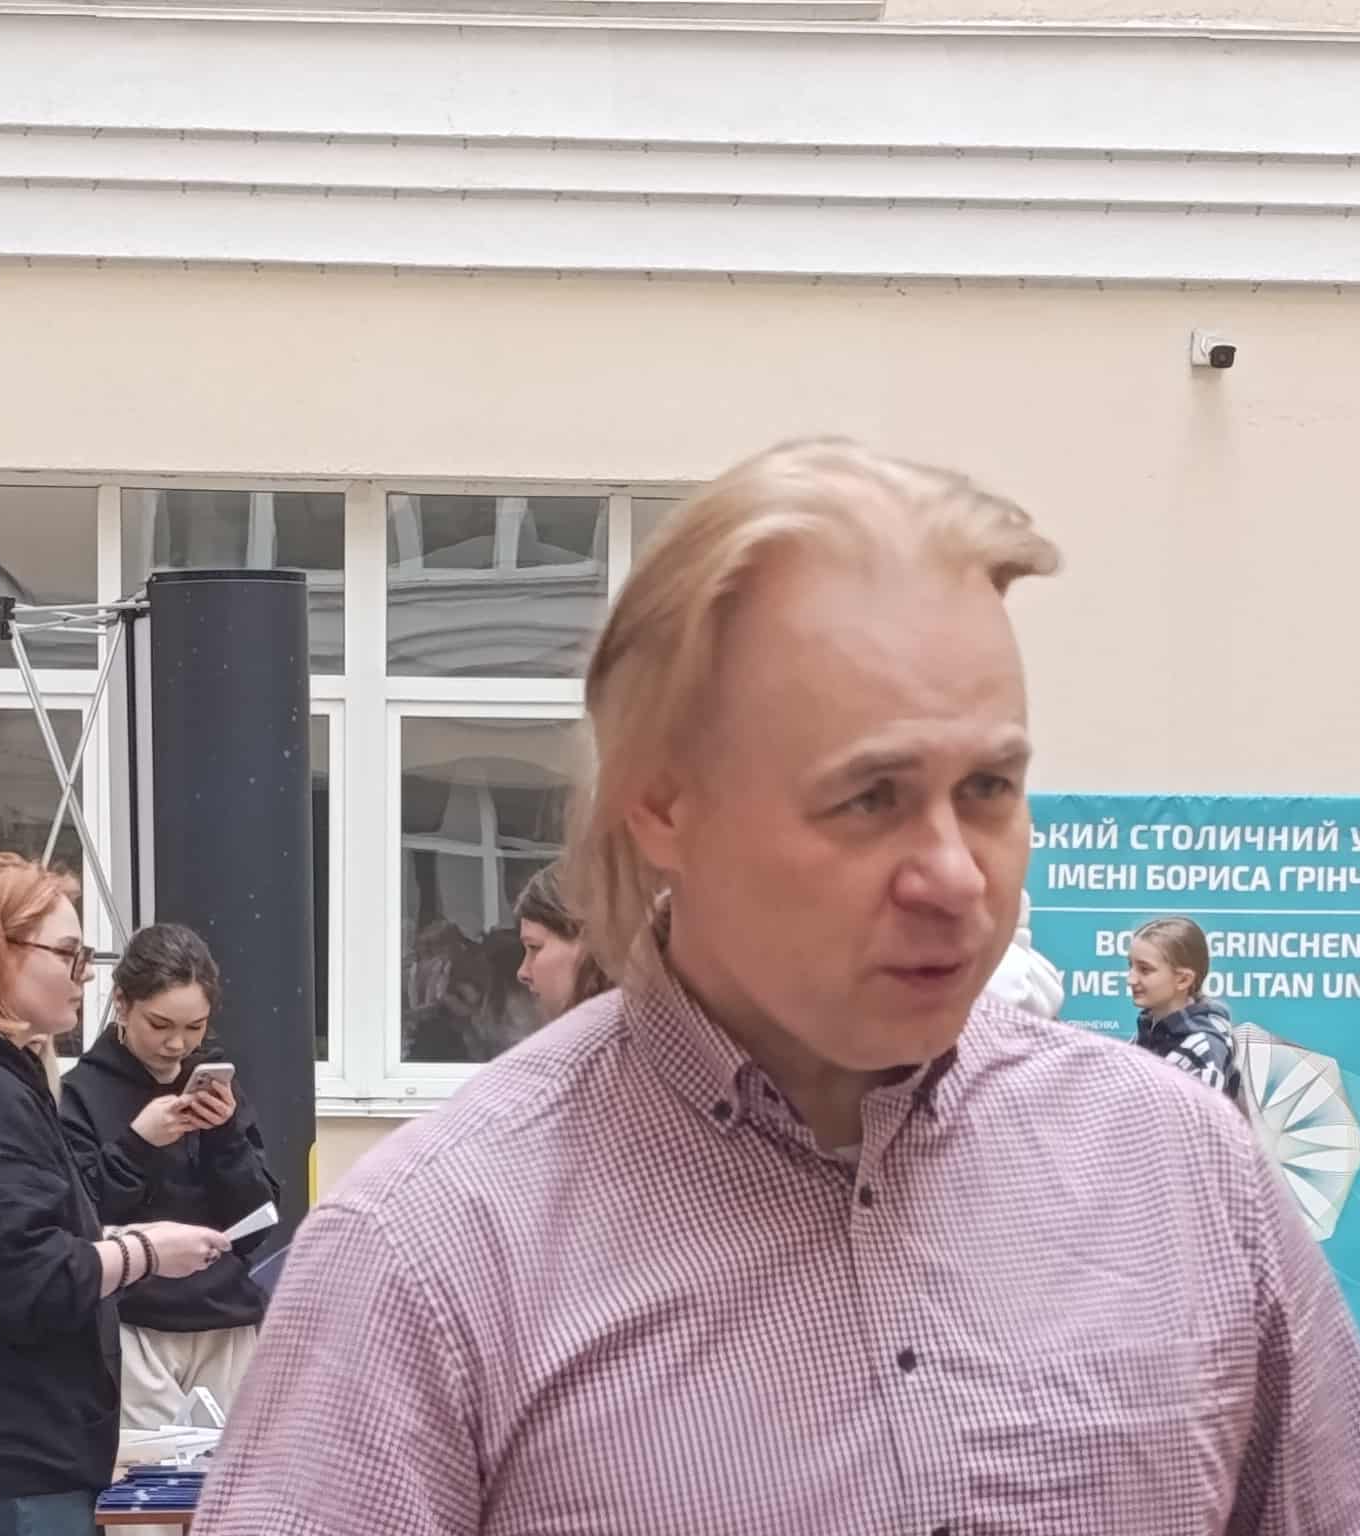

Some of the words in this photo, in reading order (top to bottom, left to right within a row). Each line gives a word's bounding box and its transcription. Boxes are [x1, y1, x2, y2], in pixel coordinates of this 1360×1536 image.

[1130, 820, 1339, 852] СТОЛИЧНИЙ
[1047, 864, 1138, 890] ІМЕНІ
[1146, 865, 1271, 891] БОРИСА
